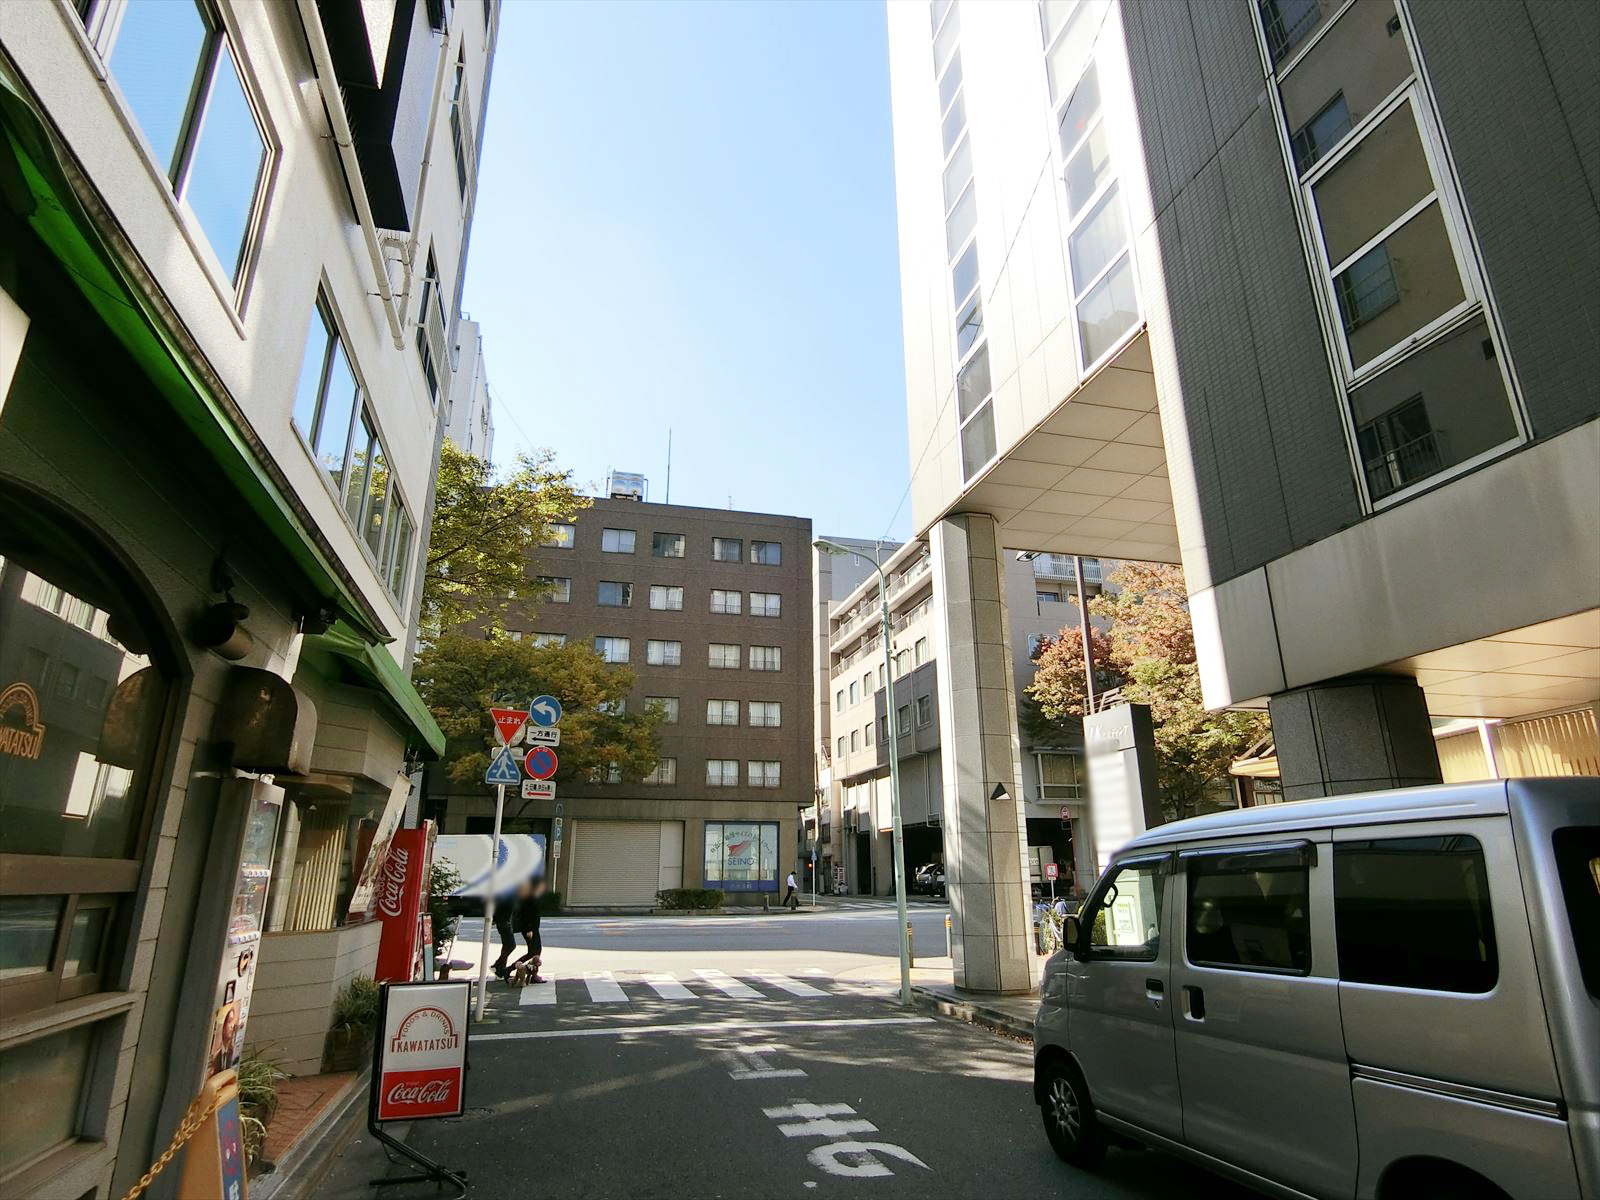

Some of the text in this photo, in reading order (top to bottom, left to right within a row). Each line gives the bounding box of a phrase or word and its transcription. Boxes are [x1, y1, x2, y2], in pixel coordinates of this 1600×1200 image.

[498, 716, 521, 725] 止まれ
[530, 730, 557, 738] 一方通行
[728, 857, 755, 866] SEINO
[401, 1014, 420, 1038] FOODS
[430, 1011, 450, 1036] DRINKS
[397, 1038, 453, 1053] KAWATATSU
[387, 1079, 454, 1105] Coca-Cola
